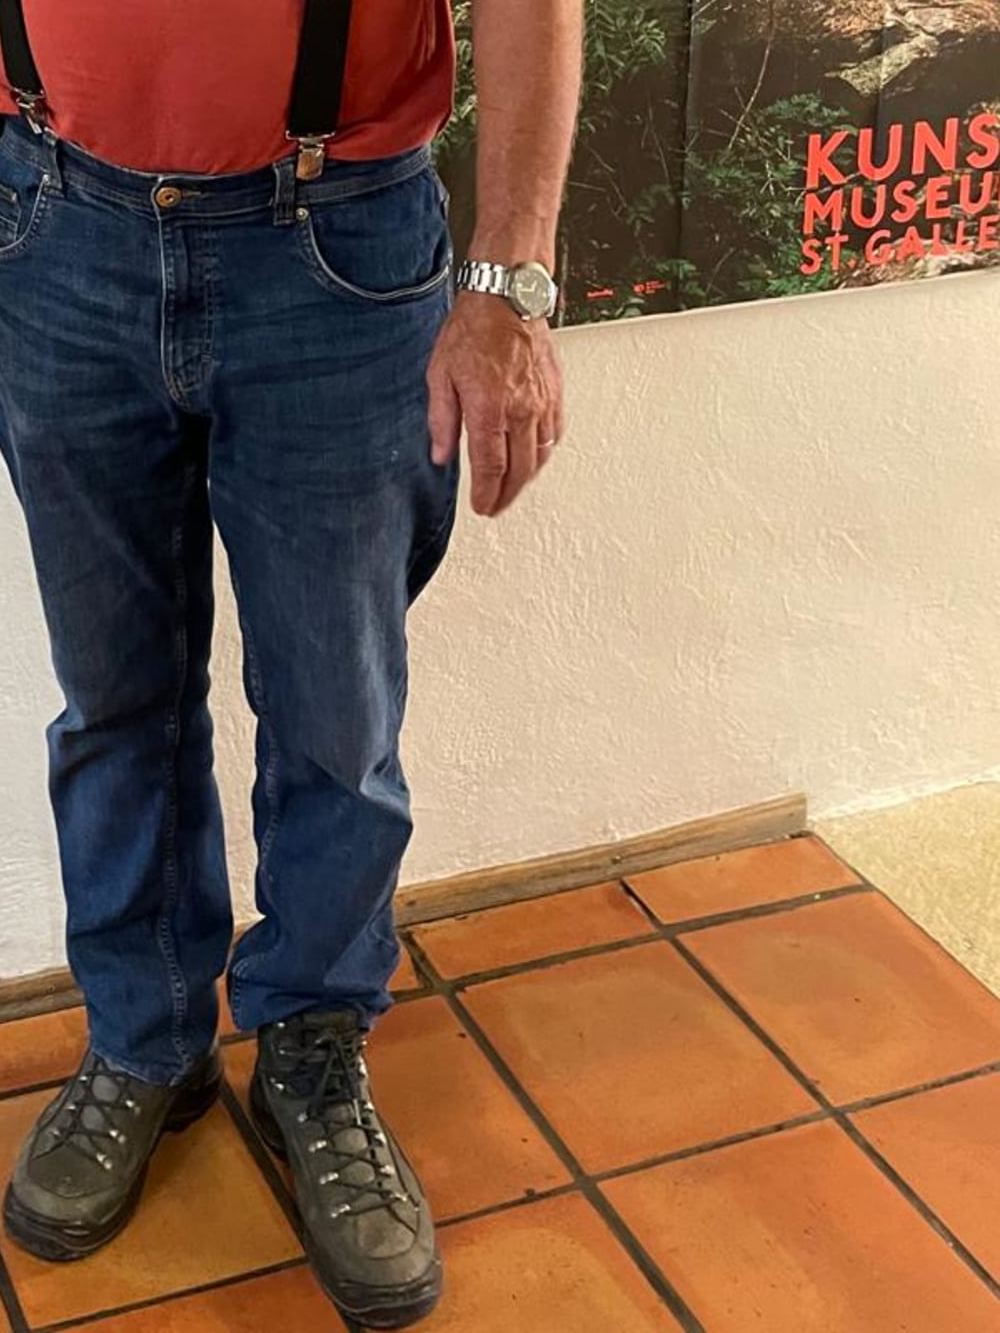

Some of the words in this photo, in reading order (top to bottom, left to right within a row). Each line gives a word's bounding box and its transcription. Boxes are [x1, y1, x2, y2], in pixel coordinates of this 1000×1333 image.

[806, 113, 1000, 189] KUNS
[803, 170, 1000, 234] MUSEU
[864, 215, 1000, 266] GALLE
